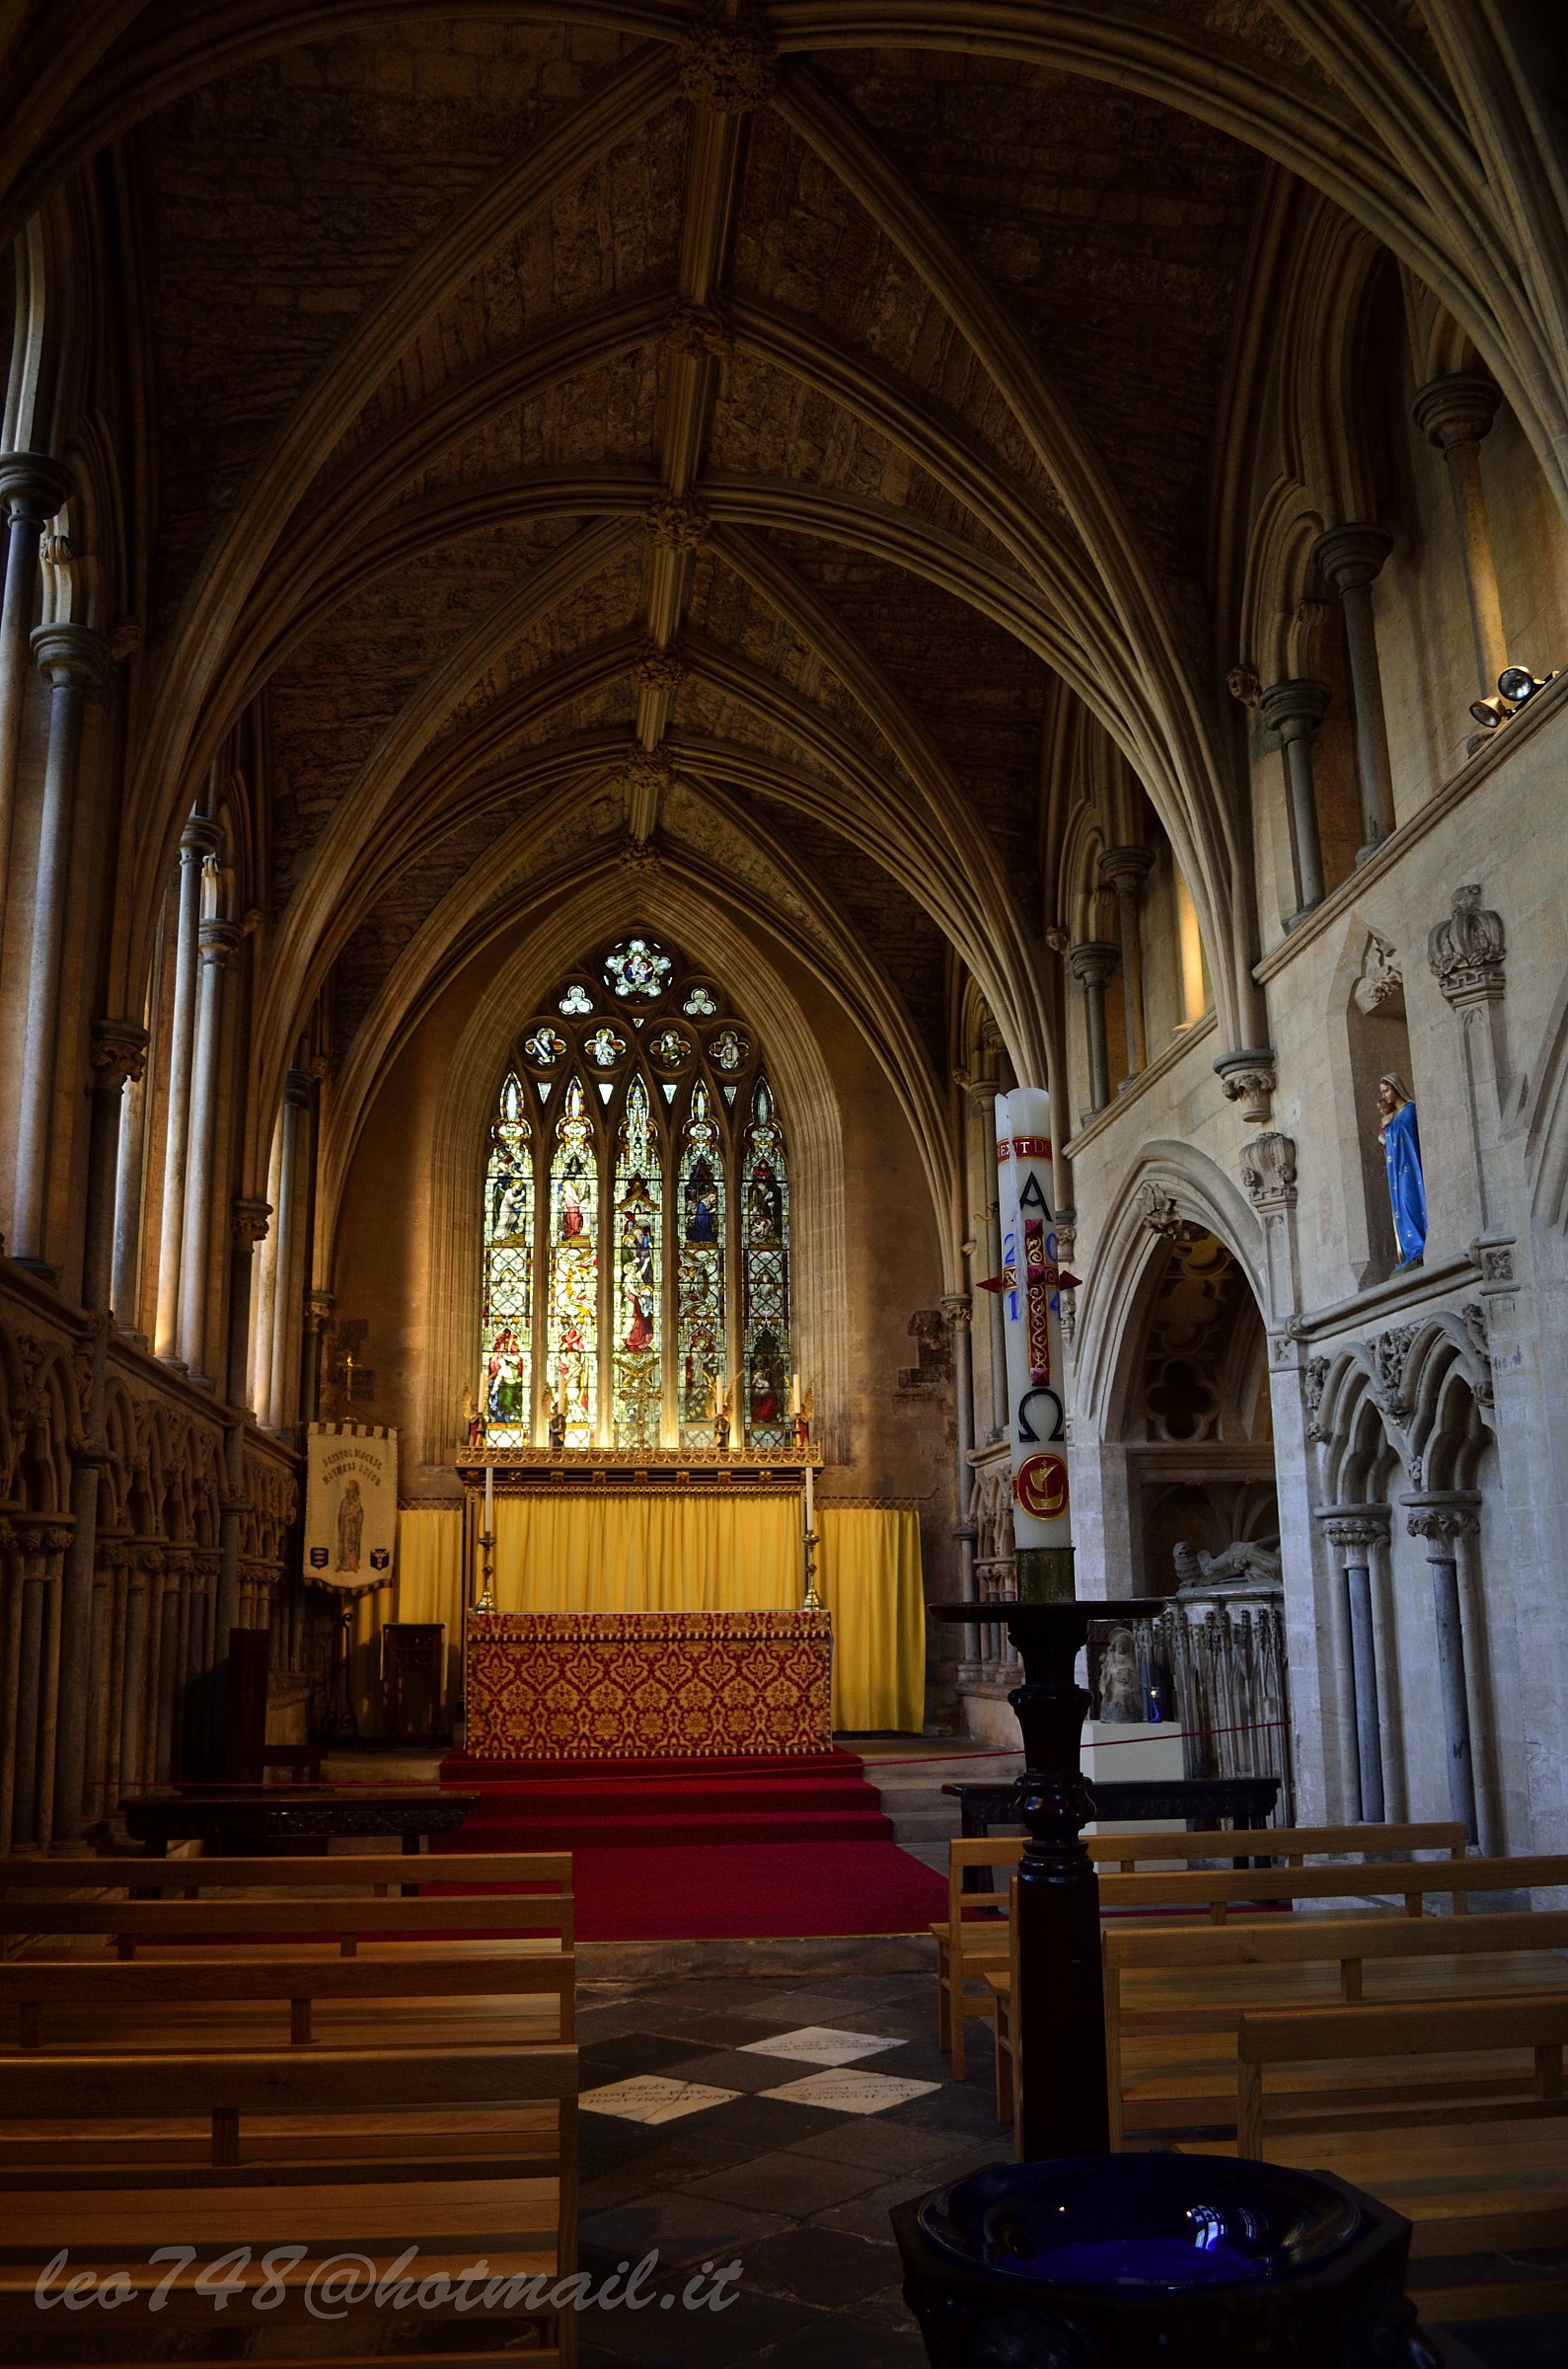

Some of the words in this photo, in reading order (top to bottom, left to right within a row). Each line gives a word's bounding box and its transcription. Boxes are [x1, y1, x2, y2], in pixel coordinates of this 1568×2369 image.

[1016, 1170, 1054, 1223] A
[1008, 1290, 1018, 1322] 1
[323, 1448, 353, 1468] BRISTOL
[359, 1464, 381, 1487] UNION
